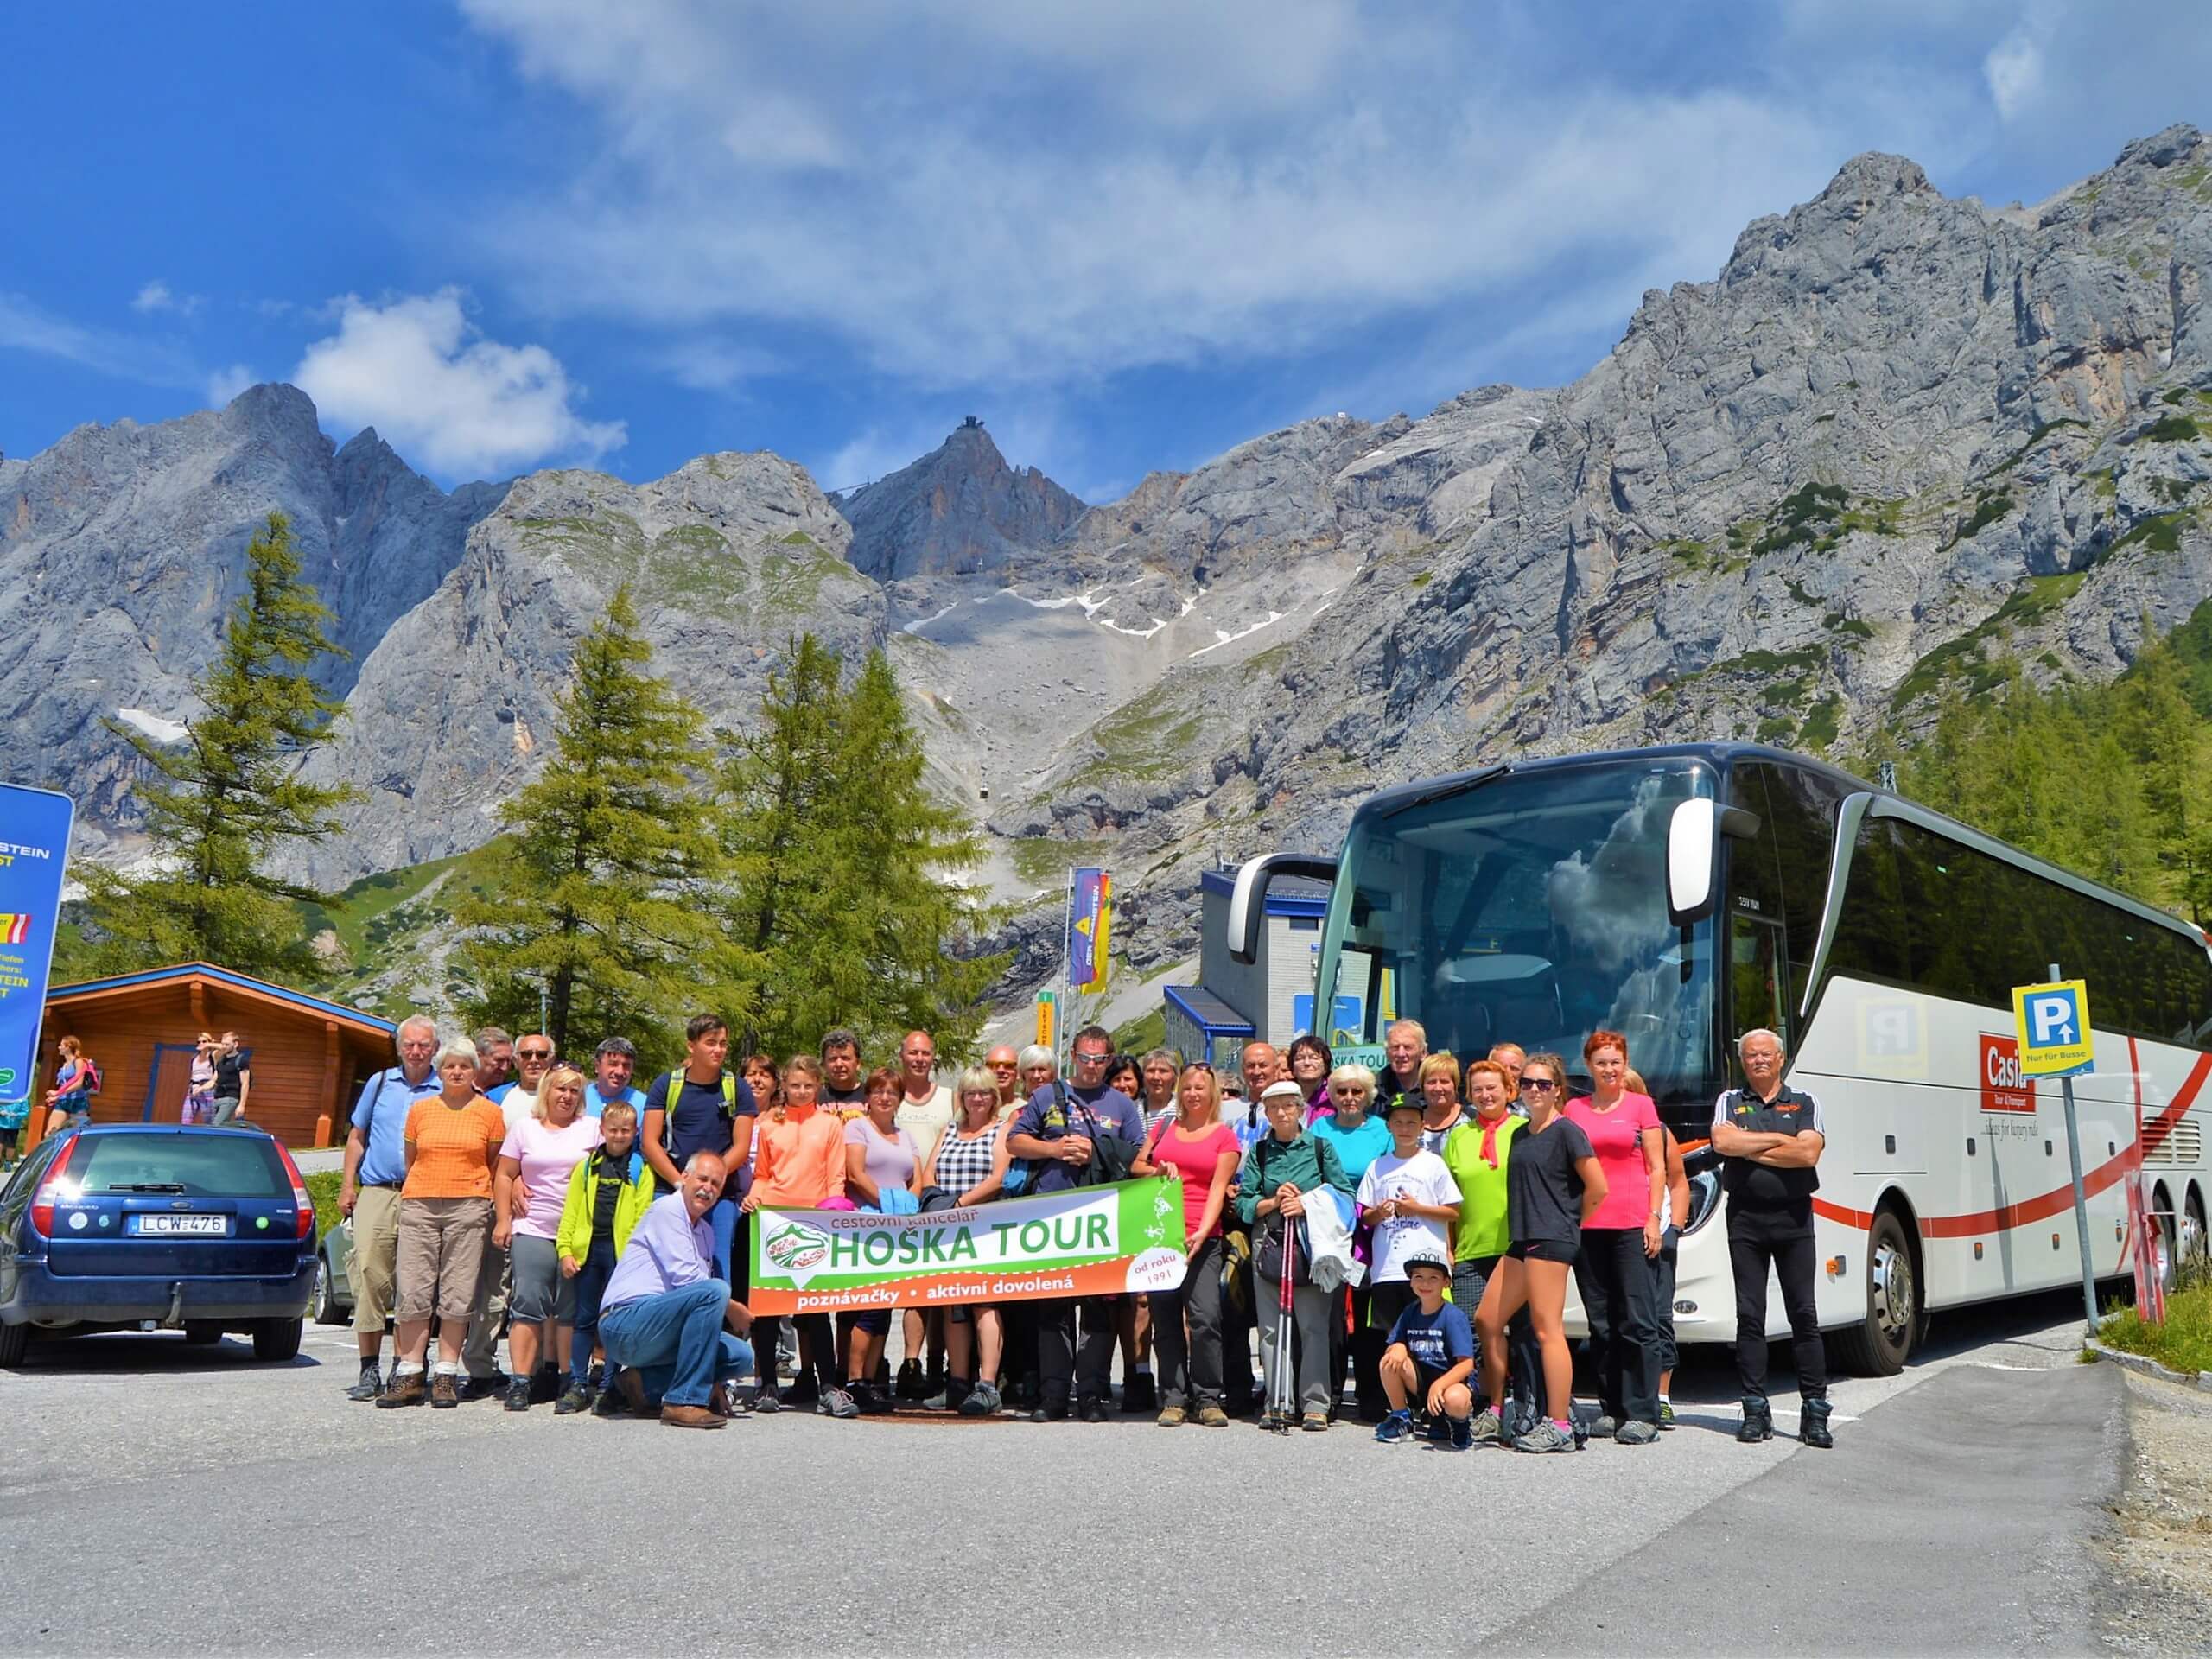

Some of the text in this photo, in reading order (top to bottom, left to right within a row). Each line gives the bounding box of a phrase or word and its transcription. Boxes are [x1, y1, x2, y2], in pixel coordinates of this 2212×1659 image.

[2033, 997, 2071, 1042] P
[1358, 1053, 1386, 1069] TOU
[2044, 1052, 2058, 1061] für
[830, 1225, 978, 1268] HOŠKA
[991, 1213, 1112, 1256] TOUR
[1135, 1253, 1177, 1274] od roku
[1147, 1270, 1172, 1285] 1991
[798, 1275, 1075, 1311] poznávačky aktivní dovolená
